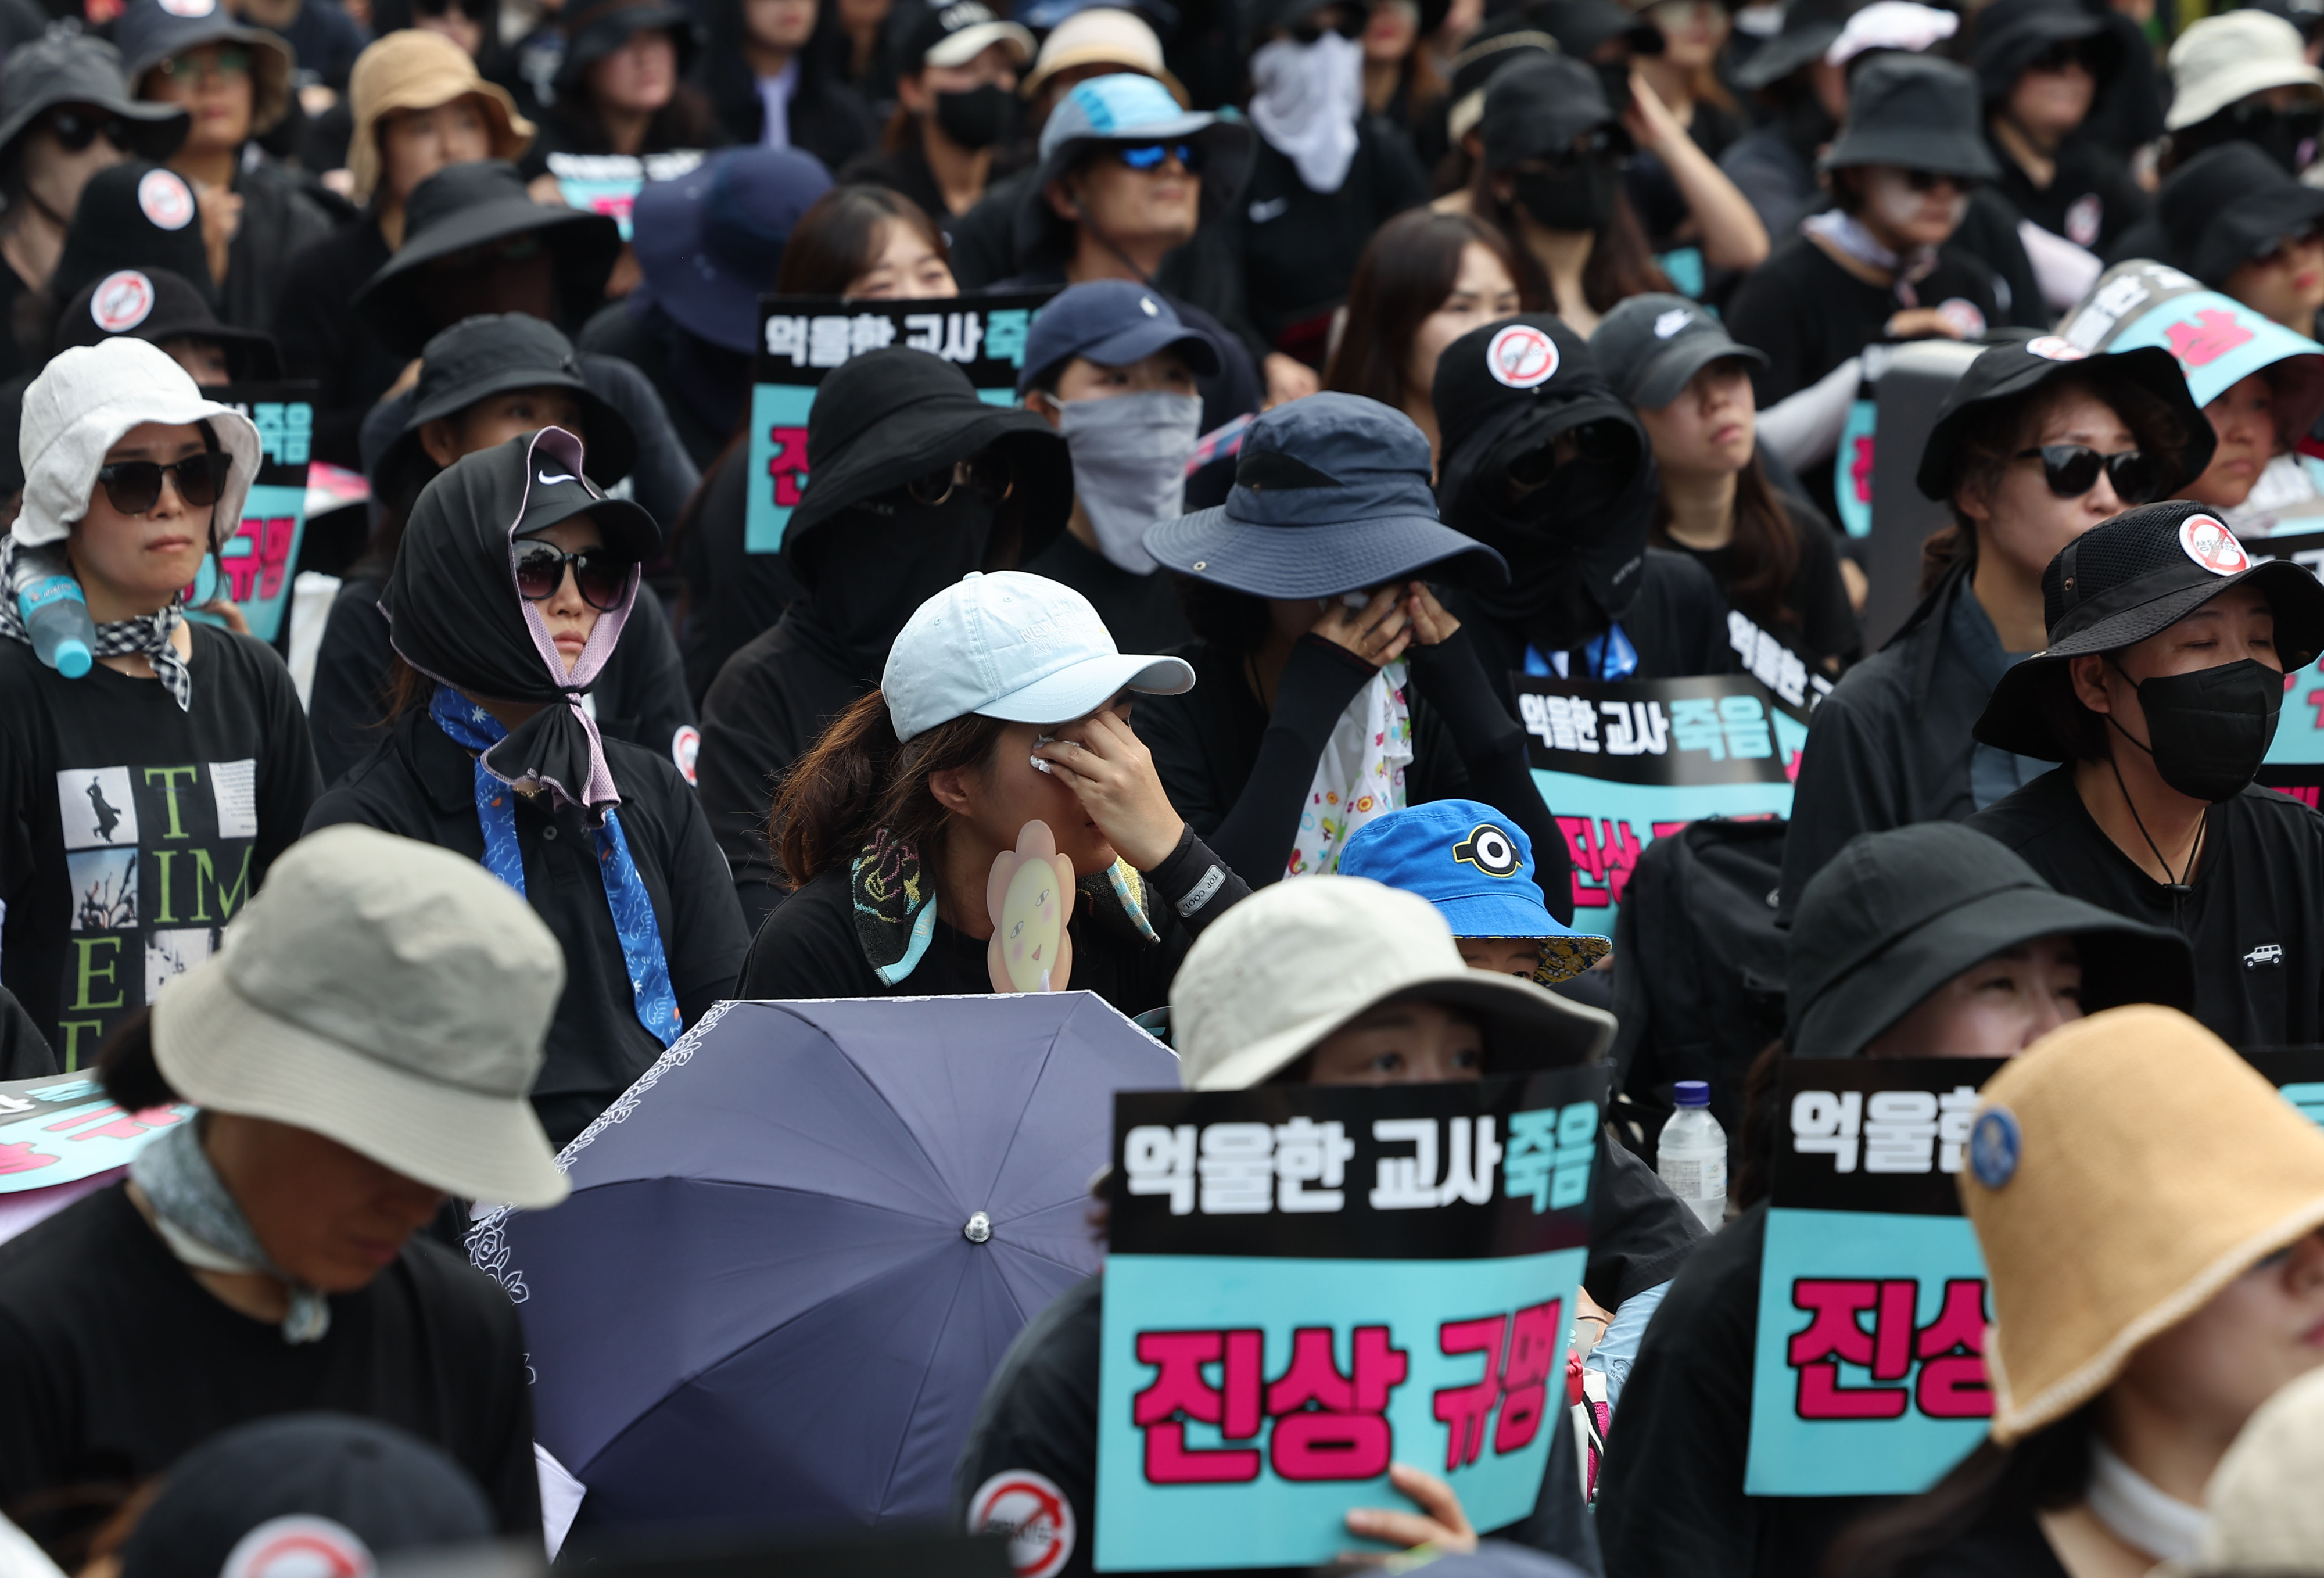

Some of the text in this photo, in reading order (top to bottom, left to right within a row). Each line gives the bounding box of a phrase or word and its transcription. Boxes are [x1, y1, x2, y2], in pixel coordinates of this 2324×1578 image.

[765, 312, 896, 367] 억울한
[904, 311, 983, 364] 교사
[253, 401, 314, 466] 죽음
[220, 517, 295, 603] 규명
[1019, 619, 1053, 643] NEW
[1519, 693, 1773, 762] 억울한 교사 죽음
[1183, 874, 1219, 909] TOP COOL
[1125, 1116, 1354, 1216] 억울한
[1369, 1115, 1501, 1210] 교사
[1502, 1100, 1599, 1215] 죽음
[1132, 1296, 1562, 1486] 진상 규명
